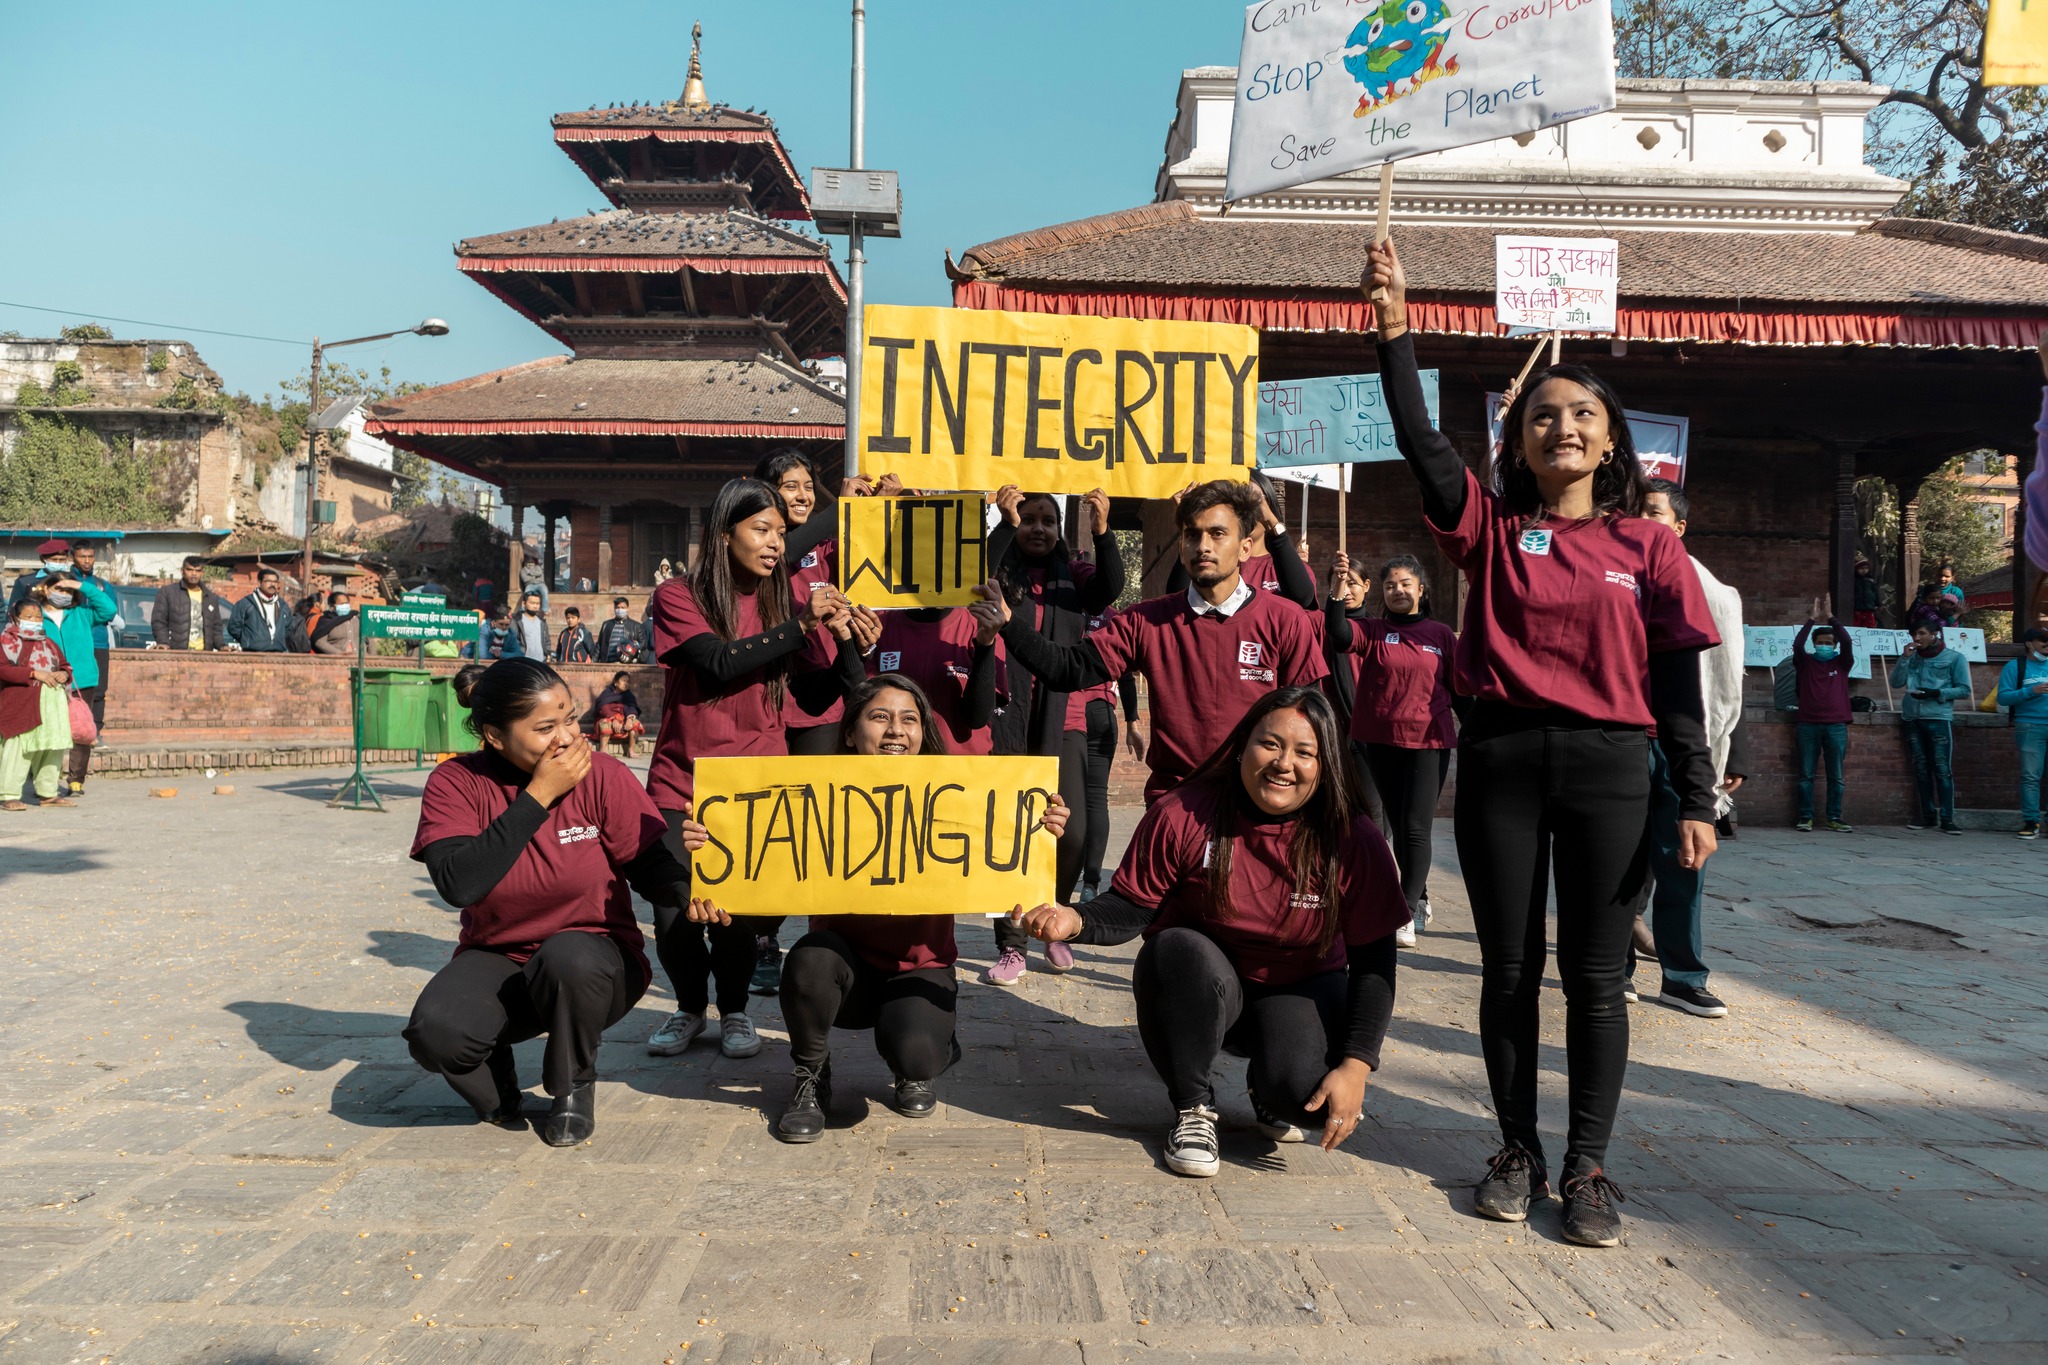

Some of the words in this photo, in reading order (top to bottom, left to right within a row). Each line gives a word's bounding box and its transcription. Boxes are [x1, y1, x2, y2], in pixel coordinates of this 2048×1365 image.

[1270, 134, 1337, 170] Save
[1365, 116, 1411, 147] the
[1444, 74, 1544, 128] Planet
[867, 336, 1258, 470] INTEGRITY
[1259, 380, 1303, 416] पैसा
[1263, 419, 1328, 456] प्रगती
[843, 498, 986, 595] WITH
[694, 781, 970, 886] STANDING
[984, 786, 1053, 877] UP
